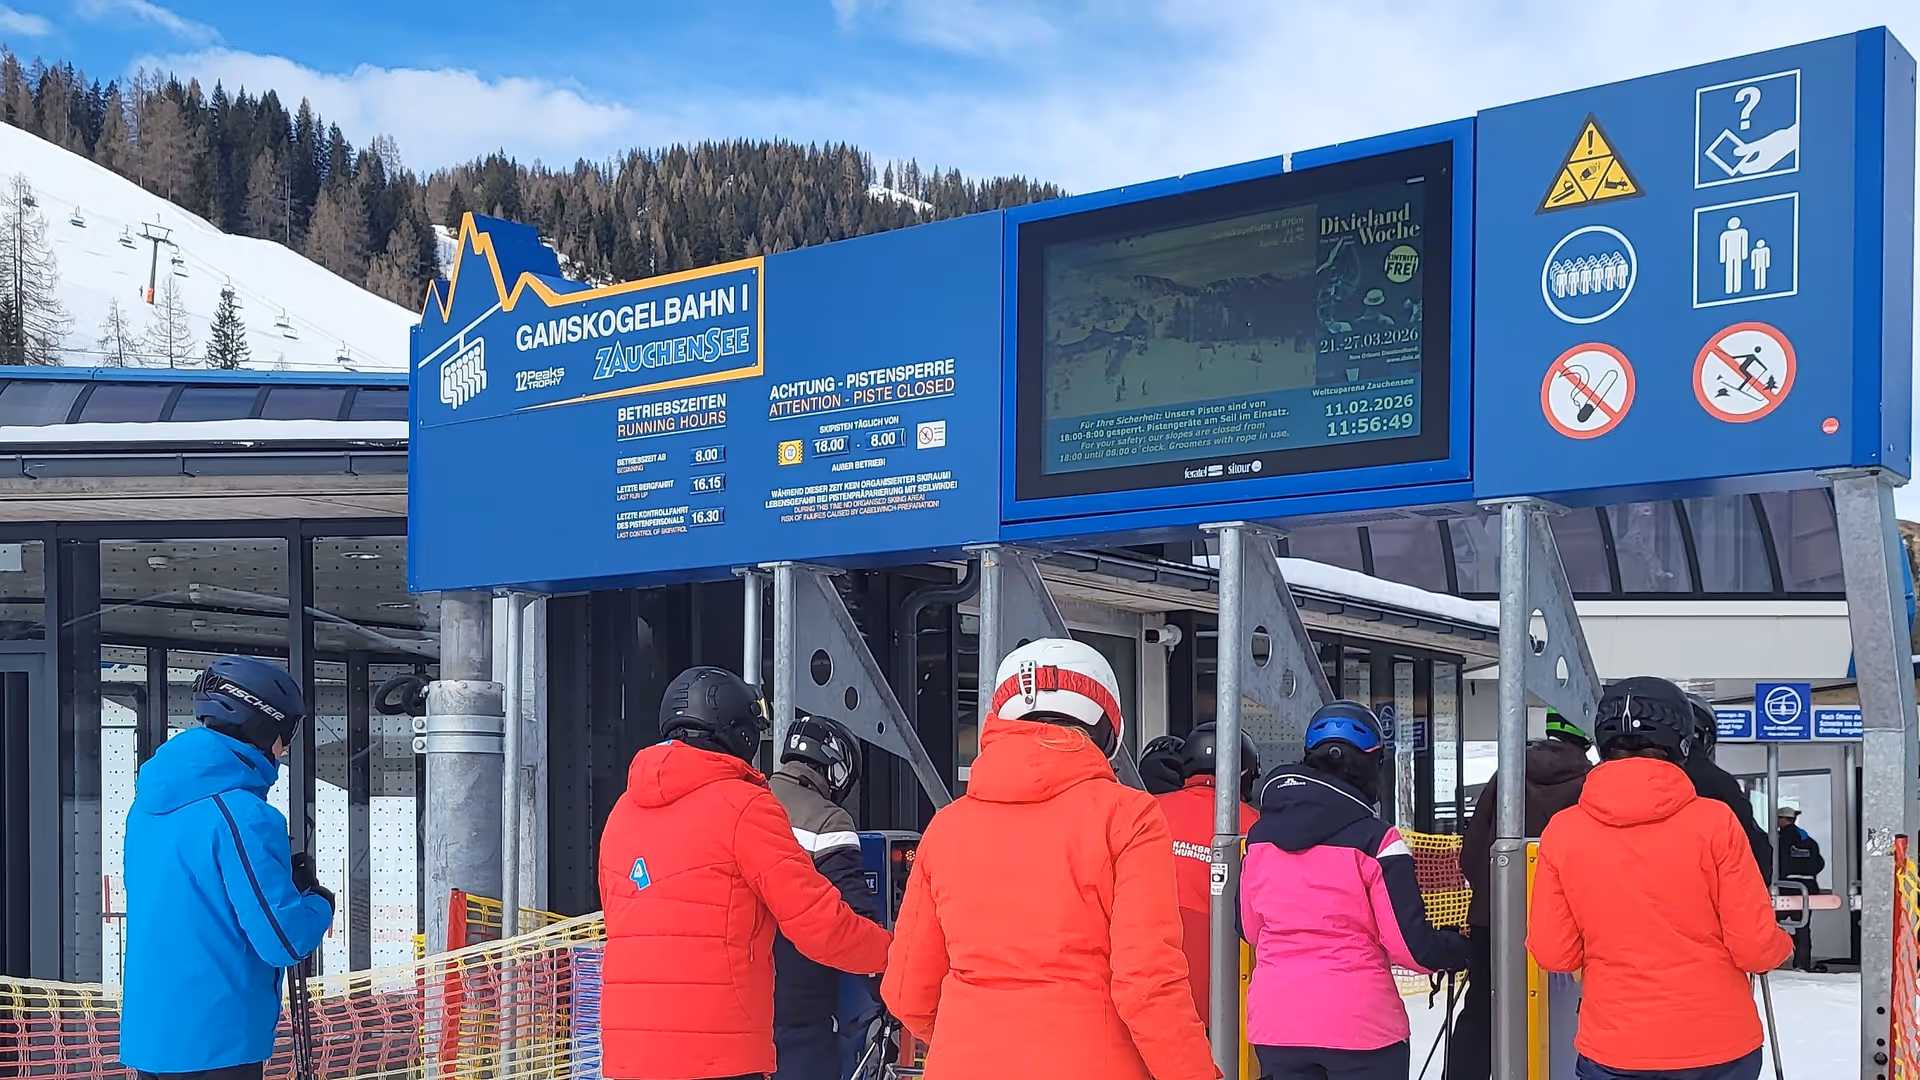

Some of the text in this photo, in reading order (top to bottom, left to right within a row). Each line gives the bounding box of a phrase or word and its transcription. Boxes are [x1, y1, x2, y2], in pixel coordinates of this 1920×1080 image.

[1320, 202, 1410, 235] Dixieland
[1359, 220, 1420, 246] Woche
[1386, 261, 1416, 276] FREI
[516, 288, 734, 352] GAMSKOGELBAHN
[1320, 328, 1418, 354] 21.-27.03.2026
[527, 377, 562, 390] TROPHY
[770, 377, 835, 400] ACHTUNG
[846, 358, 955, 389] PISTENSPERRE
[1312, 378, 1414, 396] Weltcuparena Zauchensee
[618, 393, 726, 422] BETRIEBSZEITEN
[769, 394, 841, 417] ATTENTION
[854, 386, 892, 404] PISTE
[896, 378, 955, 398] CLOSED
[1326, 394, 1414, 416] 11.02.2026
[618, 410, 726, 437] RUNNING HOURS
[854, 418, 884, 430] TÄGLICH
[884, 416, 899, 426] VON
[1060, 430, 1104, 442] 18:00-8:00
[1106, 426, 1144, 438] gesperrt.
[1147, 419, 1202, 431] Pistengeräte
[1220, 414, 1236, 423] Seil
[1254, 408, 1289, 419] Einsatz.
[1080, 421, 1094, 429] Für
[1096, 419, 1114, 428] Ihre
[1116, 413, 1162, 426] Sicherheit:
[1164, 410, 1195, 419] Unsere
[1198, 406, 1224, 415] Pisten
[1228, 402, 1246, 411] sind
[1328, 412, 1413, 437] 11:56:49
[815, 438, 844, 454] 18.00
[870, 432, 896, 446] 8.00
[1060, 452, 1082, 462] 18:00
[1084, 450, 1104, 459] until
[1106, 447, 1129, 457] 08:00
[1169, 440, 1211, 450] Groomers
[1214, 436, 1233, 445] with
[1236, 434, 1256, 443] rope
[1270, 430, 1289, 438] use.
[1080, 442, 1094, 450] For
[1096, 440, 1116, 449] your
[1166, 430, 1193, 440] slopes
[1212, 424, 1241, 434] closed
[1244, 422, 1265, 430] from
[657, 453, 666, 461] AB
[695, 448, 718, 462] 8.00
[1184, 466, 1207, 479] feratel
[1227, 462, 1251, 474] sitour
[617, 480, 674, 493] LETZTE BERGFAHRT
[693, 476, 721, 491] 16.15
[771, 488, 804, 498] WÄHREND
[805, 484, 828, 494] DIESER
[829, 483, 843, 492] ZEIT
[844, 481, 860, 490] KEIN
[861, 474, 915, 488] ORGANISIERTER
[617, 493, 629, 501] LAST
[765, 496, 816, 508] LEBENSGEFAHR
[829, 487, 903, 502] PISTENPRÄPARIERUNG
[905, 485, 916, 493] MIT
[617, 506, 689, 521] LETZTE KONTROLLFAHRT
[617, 516, 684, 530] DES PISTENPERSONALS
[691, 509, 719, 524] 16.30
[629, 529, 652, 537] CONTROL
[219, 683, 286, 722] FISCHER
